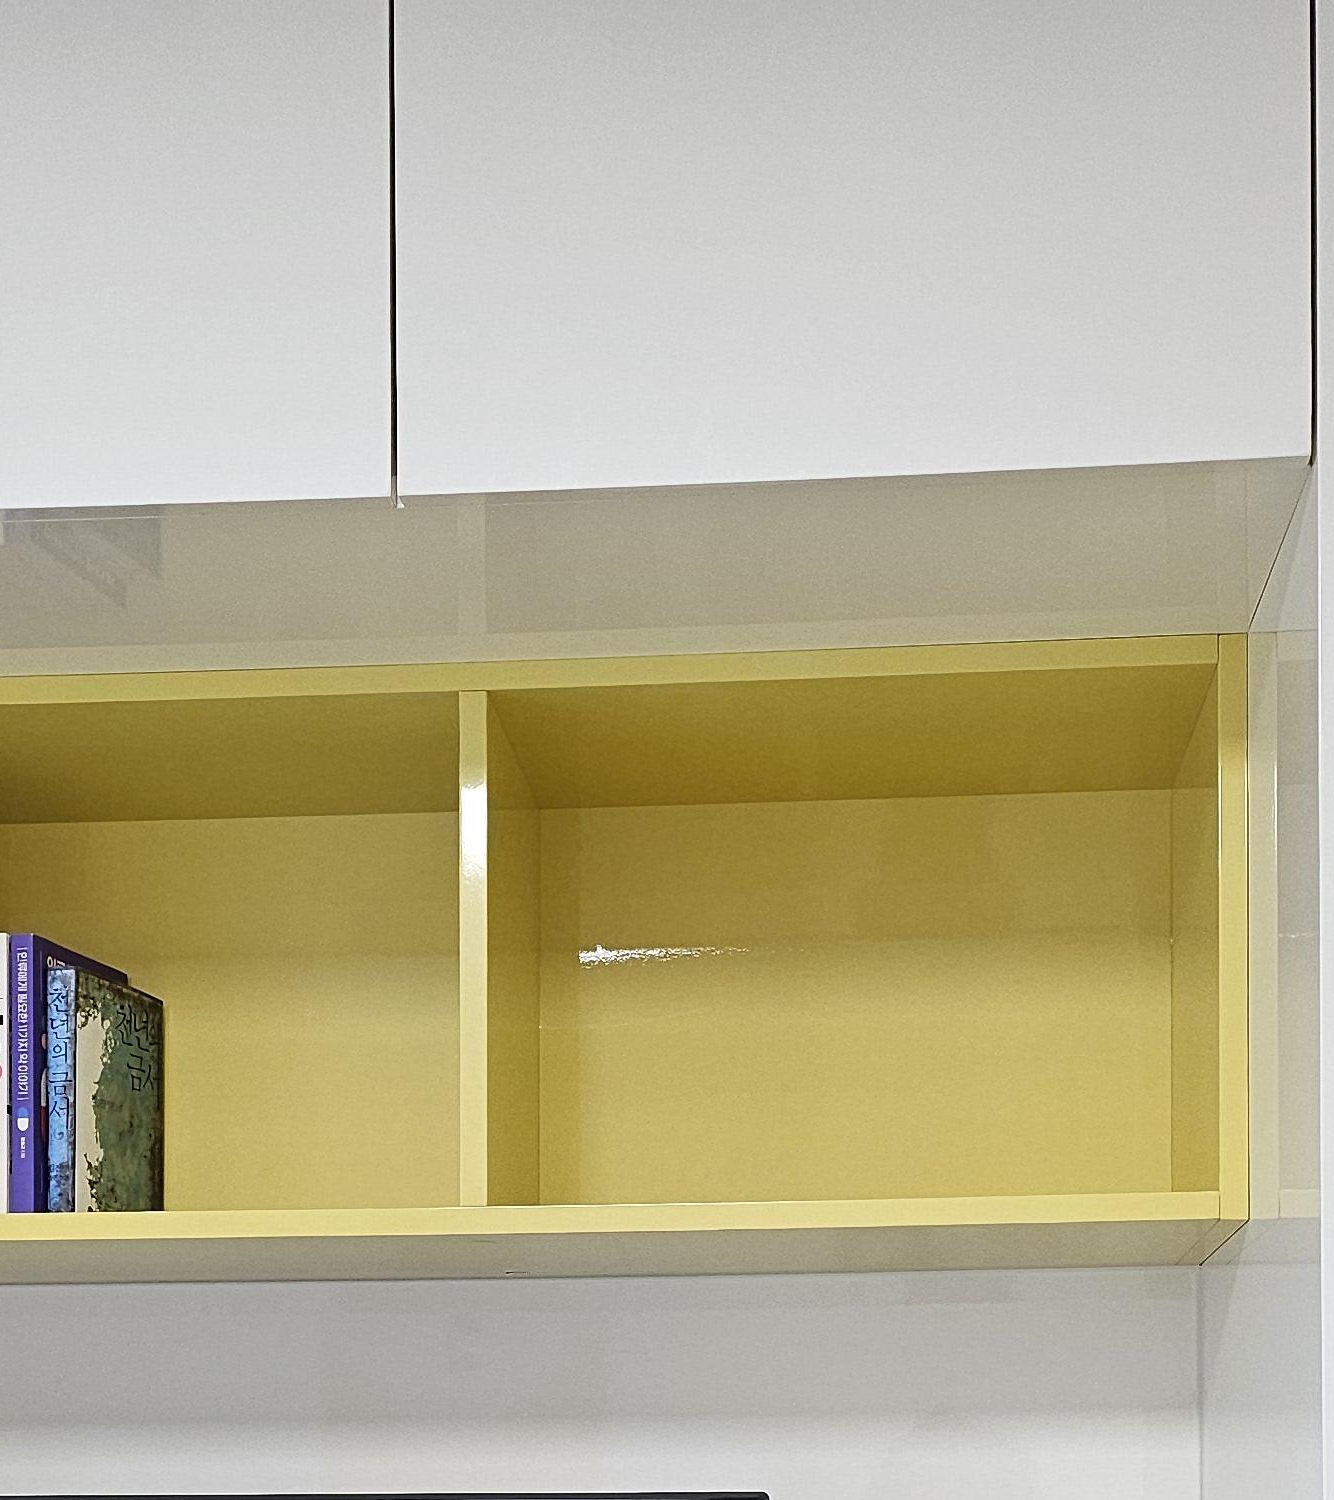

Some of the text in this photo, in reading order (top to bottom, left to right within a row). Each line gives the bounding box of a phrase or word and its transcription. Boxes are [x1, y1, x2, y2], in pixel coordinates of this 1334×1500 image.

[16, 952, 28, 991] 인류에게
[16, 993, 28, 1023] 필요한
[48, 986, 70, 1065] 천년의
[16, 1065, 28, 1094] 이야기
[48, 1071, 73, 1130] 금서
